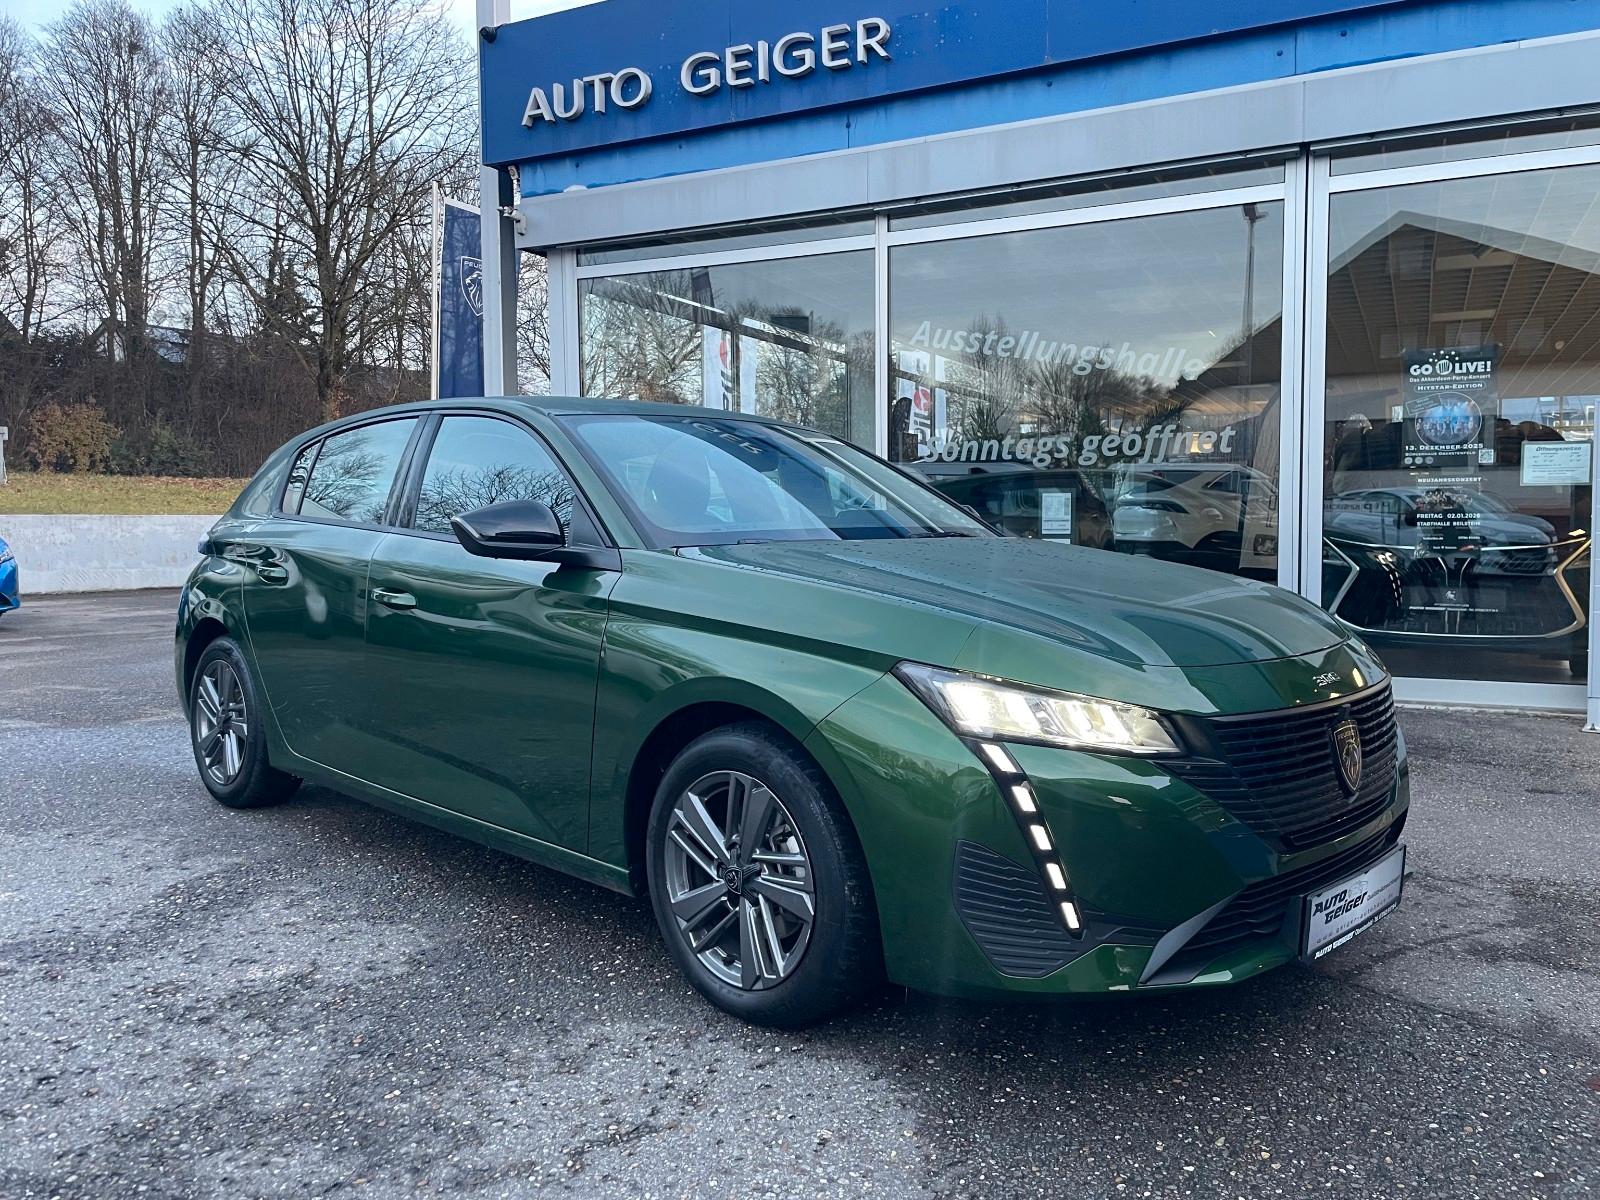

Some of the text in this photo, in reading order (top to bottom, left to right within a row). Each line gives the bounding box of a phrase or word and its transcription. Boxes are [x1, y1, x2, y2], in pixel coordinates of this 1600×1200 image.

[521, 17, 891, 127] AUTO GEIGER
[909, 320, 1204, 381] Ausstellungshalle
[1410, 361, 1492, 376] GO LIVE!
[926, 424, 1237, 467] Sonntags geöffnet
[1312, 889, 1348, 916] AUTO
